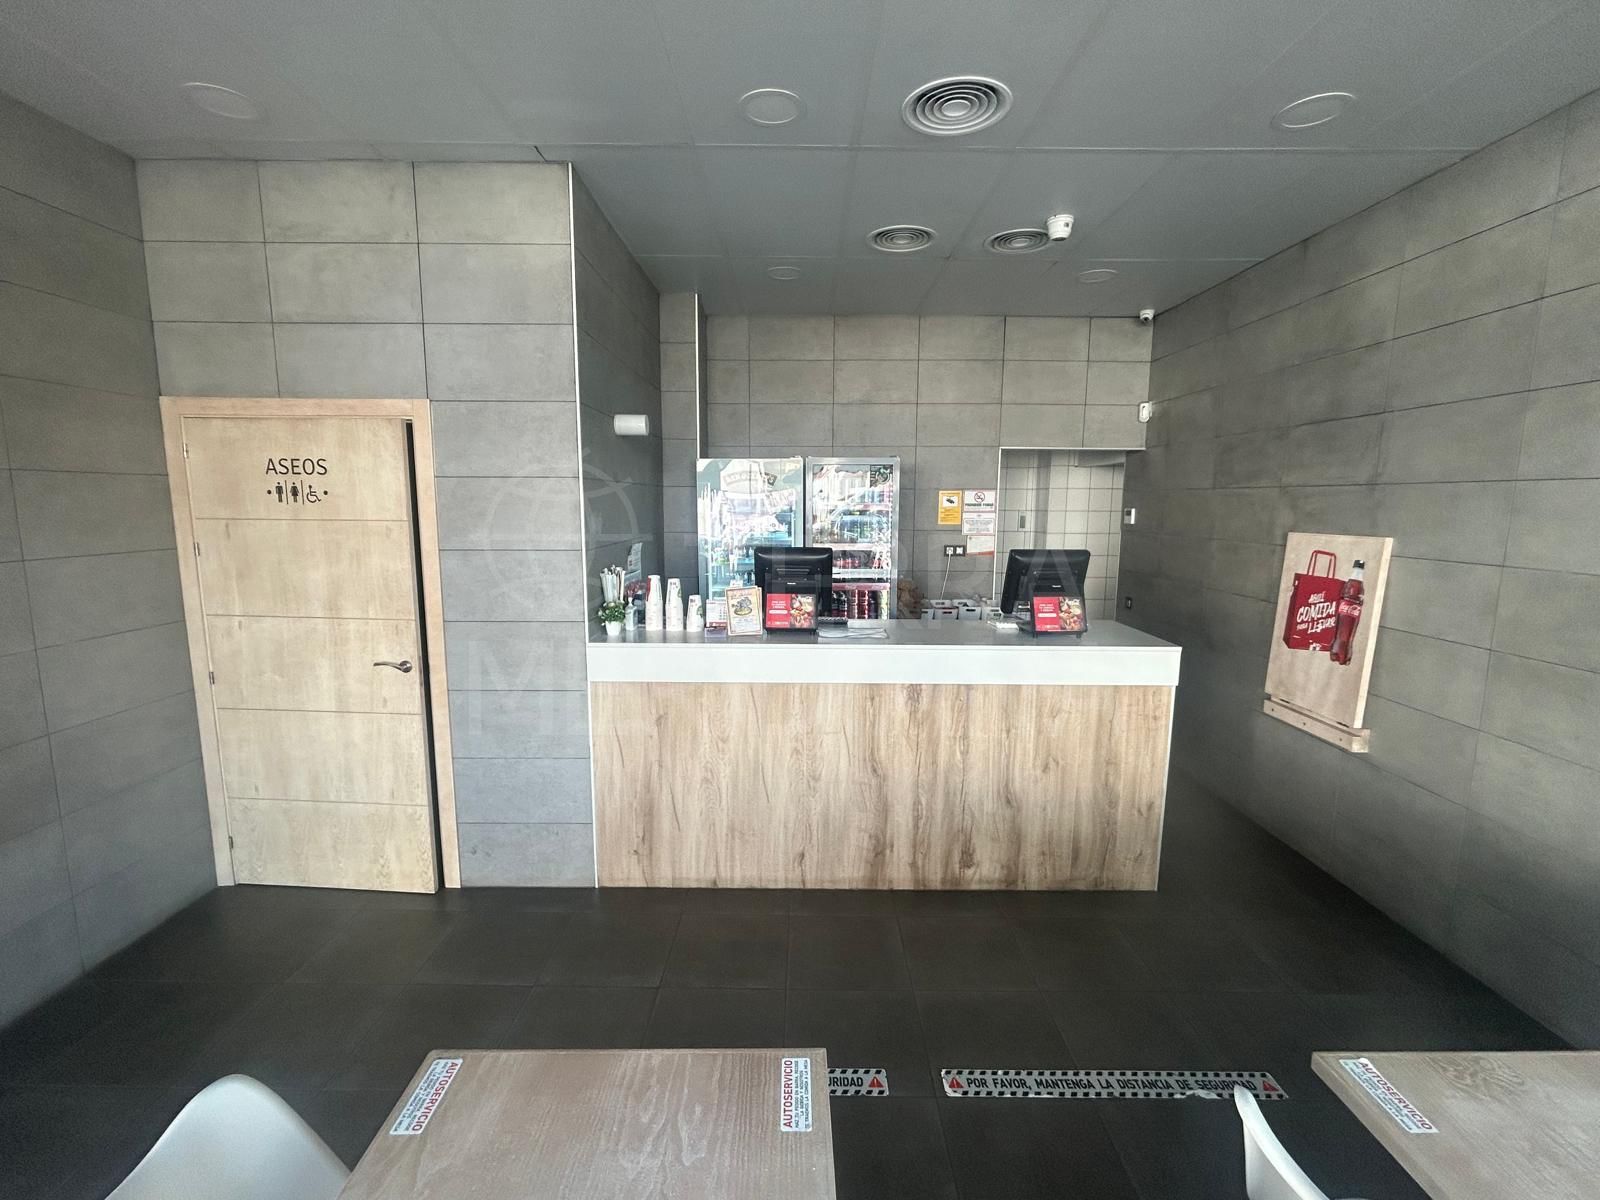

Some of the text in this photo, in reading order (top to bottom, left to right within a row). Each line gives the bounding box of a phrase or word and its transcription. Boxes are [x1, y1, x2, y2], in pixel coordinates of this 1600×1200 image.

[265, 457, 328, 476] ASEOS
[1296, 601, 1337, 623] COMIDA
[411, 1061, 459, 1132] AUTOSERVICIO
[783, 1060, 793, 1128] AUTOSERVICIO
[966, 1077, 989, 1089] POR
[993, 1078, 1032, 1090] FAVOR,
[1034, 1078, 1095, 1090] MANTENGA
[1099, 1079, 1114, 1090] LA
[1116, 1079, 1174, 1090] DISTANCIA
[1176, 1080, 1193, 1090] DE
[1358, 1061, 1433, 1131] AUTOSERVICIO
